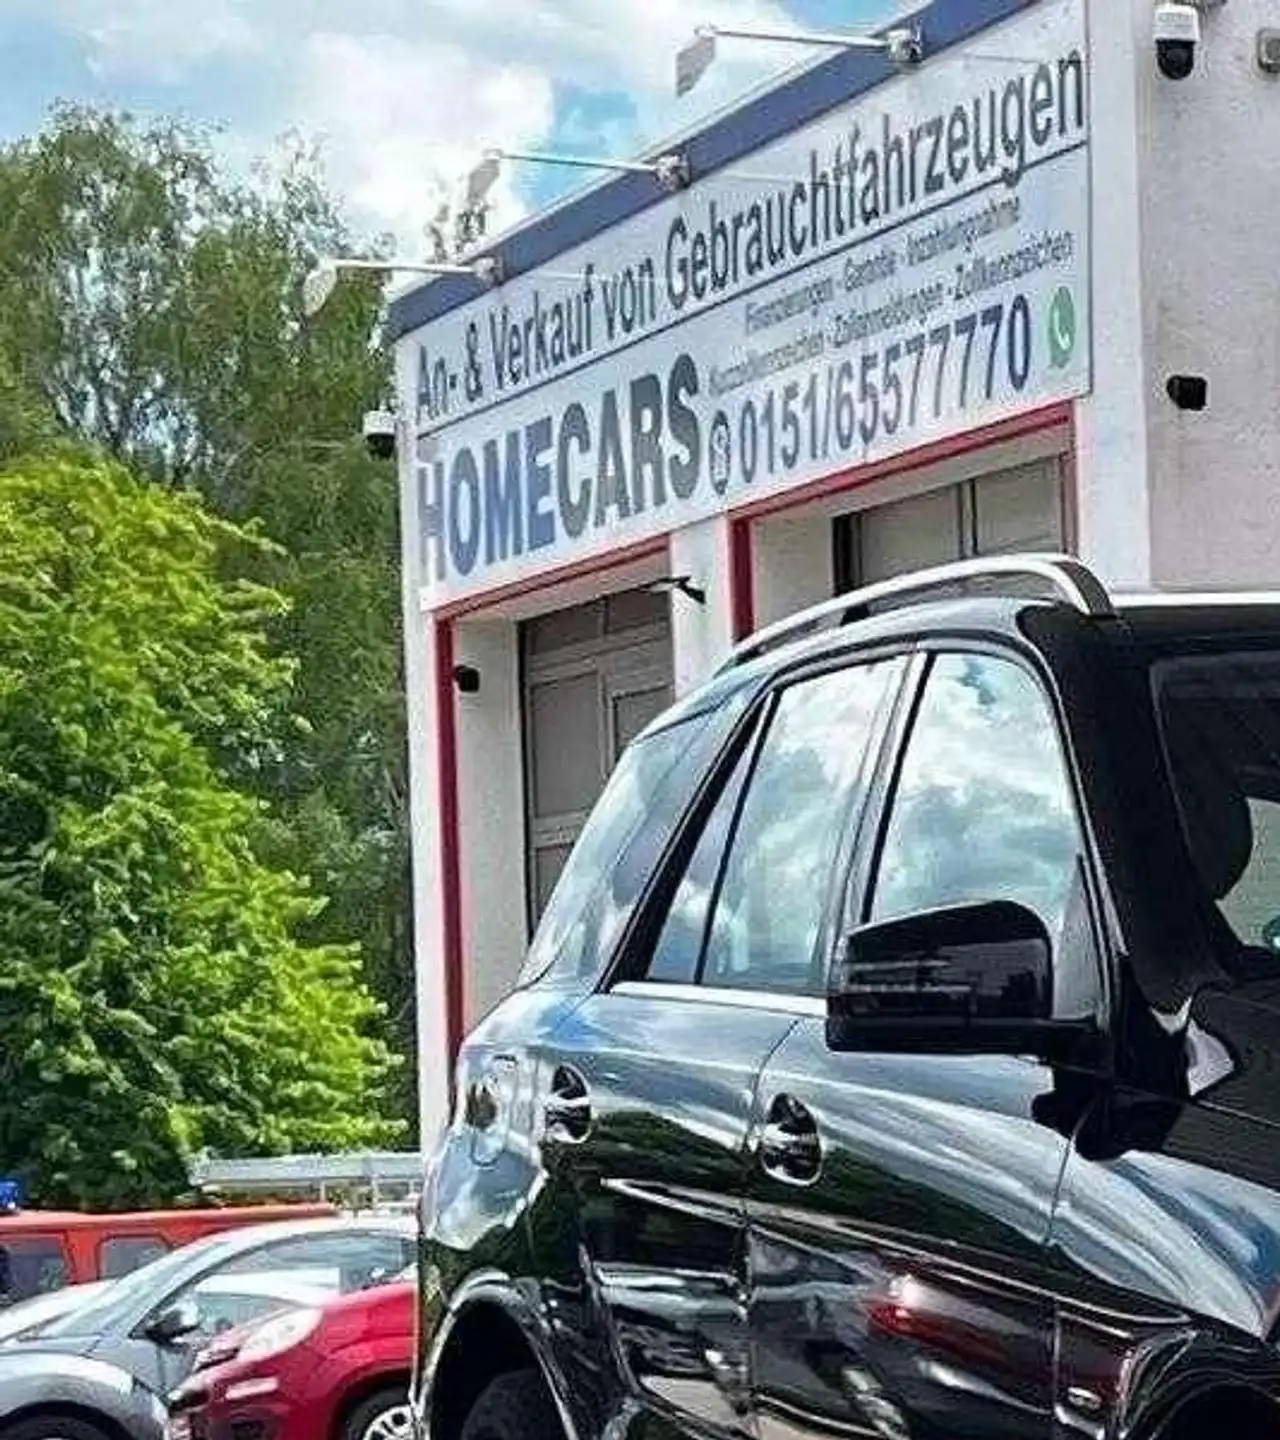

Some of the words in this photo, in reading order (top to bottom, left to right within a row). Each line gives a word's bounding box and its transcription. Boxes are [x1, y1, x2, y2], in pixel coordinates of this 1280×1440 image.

[416, 346, 456, 425] An-
[464, 320, 482, 401] &
[490, 284, 594, 390] Verkauf
[600, 262, 656, 340] von
[666, 48, 1084, 309] Gebrauchtfahrzeugen
[416, 353, 700, 585] HOMECARS
[739, 293, 1030, 484] 0151/65577770
